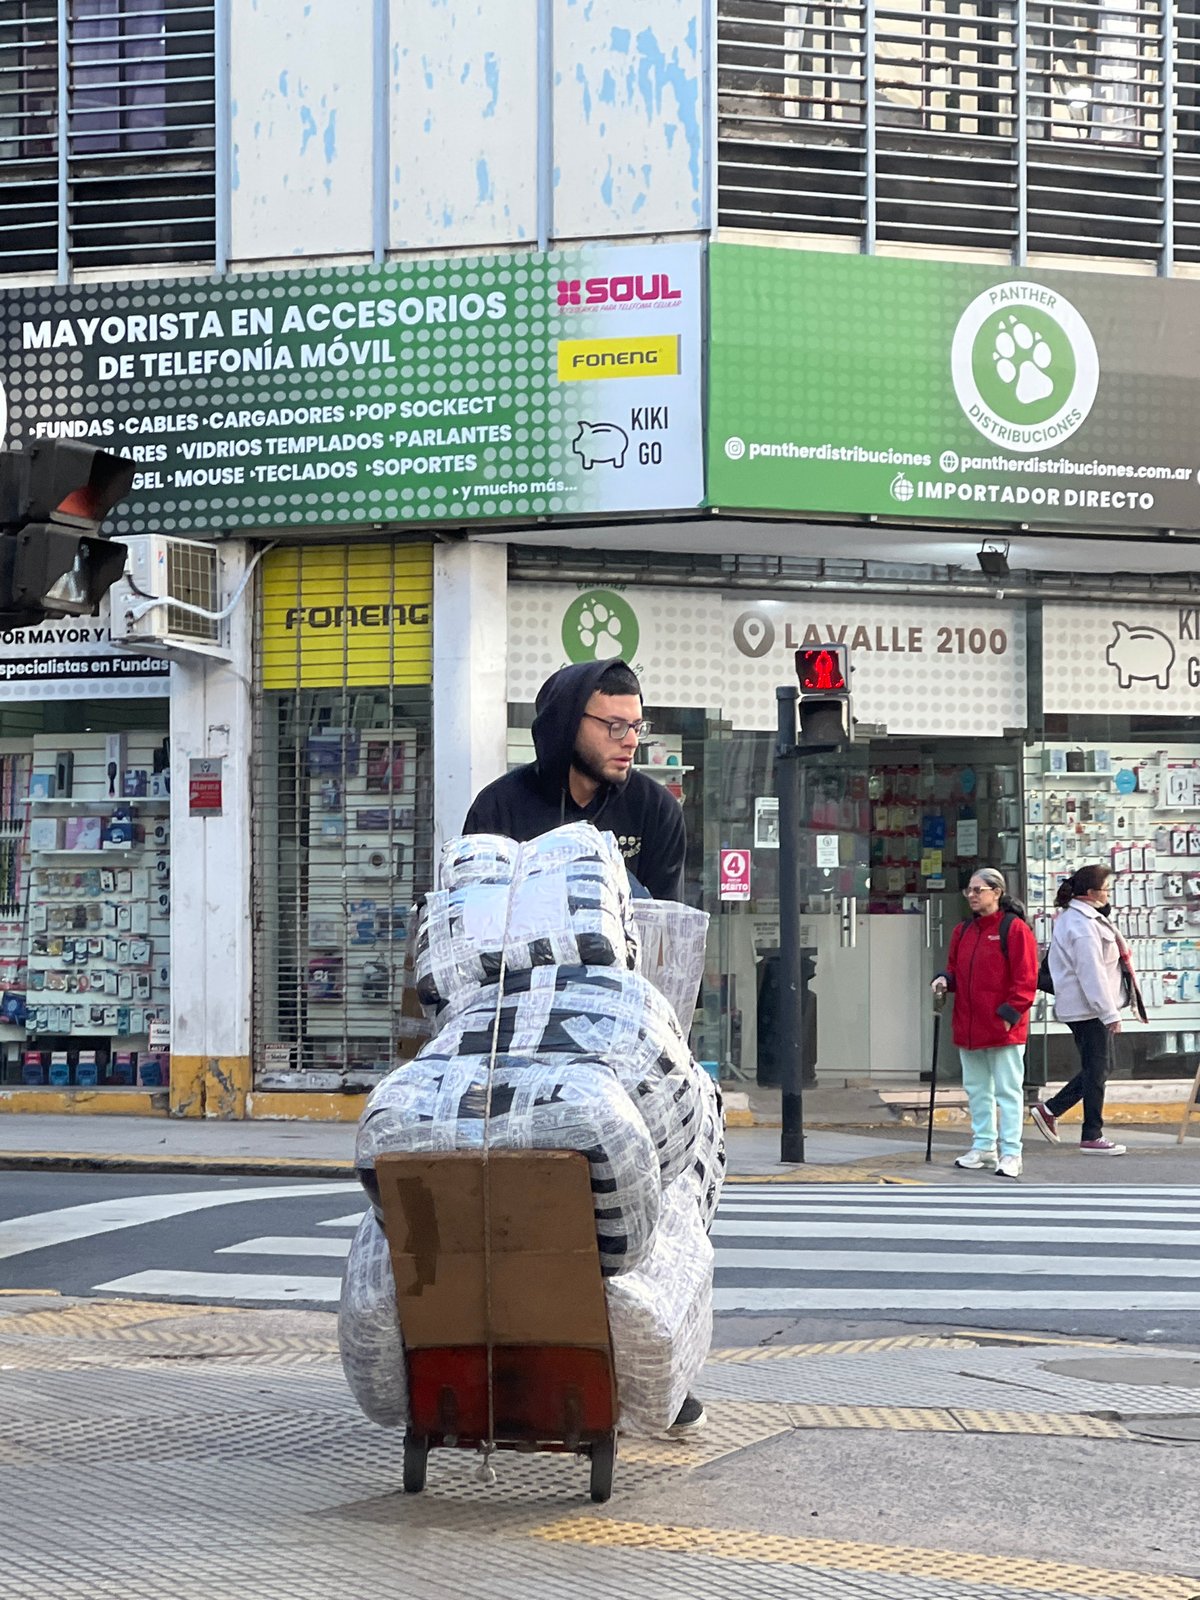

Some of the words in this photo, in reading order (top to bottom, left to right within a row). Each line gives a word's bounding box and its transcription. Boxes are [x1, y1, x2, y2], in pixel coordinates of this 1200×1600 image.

[585, 274, 681, 304] SOUL
[989, 286, 1057, 309] PANTHER
[22, 310, 225, 350] MAYORISTA
[231, 306, 274, 336] EN
[280, 291, 507, 334] ACCESORIOS
[98, 355, 134, 380] DE
[140, 338, 294, 378] TELEFONÍA
[300, 335, 396, 369] MÓVIL
[572, 351, 658, 368] FONENG
[35, 418, 115, 439] FUNDAS
[125, 413, 199, 434] CABLES
[209, 405, 345, 430] CARGADORES
[356, 405, 396, 422] POP
[400, 396, 497, 418] SOCKECT
[631, 406, 669, 431] KIKI
[968, 404, 1082, 443] DISTRIBUCIONES
[181, 439, 262, 460] VIDRIOS
[265, 432, 384, 456] TEMPLADOS
[394, 425, 513, 449] PARLANTES
[639, 442, 662, 465] GO
[749, 442, 932, 466] pantherdistribuciones
[131, 472, 164, 490] GEL
[174, 467, 245, 488] MOUSE
[254, 460, 358, 483] TECLADOS
[372, 454, 478, 477] SOPORTES
[961, 455, 1192, 481] pantherdistribuciones.com.ar
[461, 486, 472, 500] y
[474, 481, 528, 497] mucho
[530, 478, 578, 493] más...
[917, 481, 1060, 506] IMPORTADOR
[1065, 490, 1155, 509] DIRECTO
[285, 604, 429, 630] FONENG
[1179, 609, 1200, 640] KI
[0, 630, 25, 645] OR
[29, 628, 91, 644] MAYOR
[94, 628, 105, 642] Y
[785, 623, 923, 653] LAVALLE
[937, 626, 1008, 655] 2100
[0, 658, 89, 680] specialistas
[92, 661, 110, 673] en
[113, 658, 169, 672] Fundas
[727, 856, 741, 874] 4
